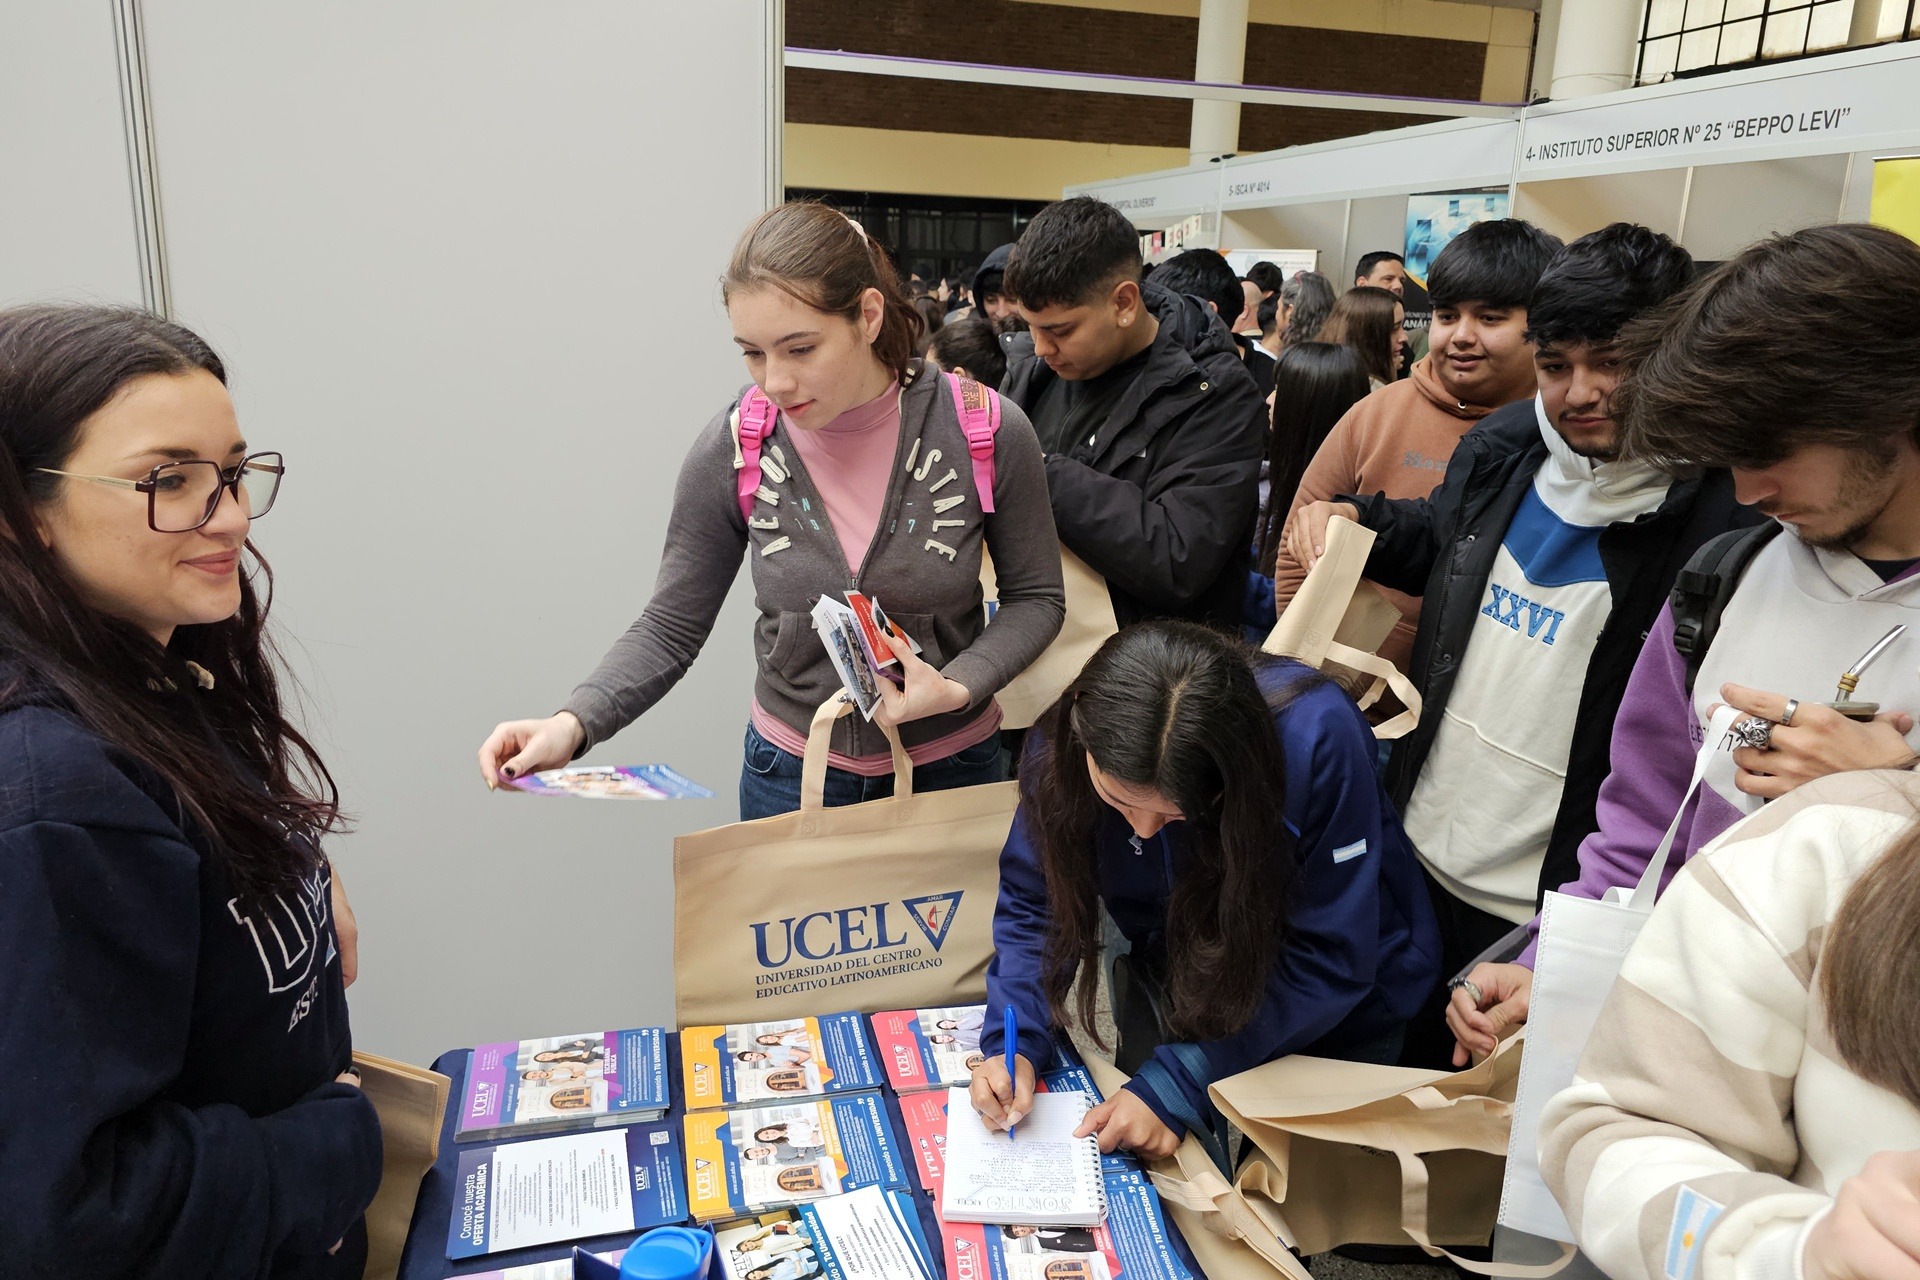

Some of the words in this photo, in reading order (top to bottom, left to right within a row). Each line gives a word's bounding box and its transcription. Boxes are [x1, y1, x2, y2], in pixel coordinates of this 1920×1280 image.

[1525, 146, 1536, 162] 4-
[1539, 138, 1603, 160] INSTITUTO
[1607, 127, 1679, 152] SUPERIOR
[1704, 123, 1722, 142] 25
[1481, 583, 1565, 645] XXVI
[749, 902, 908, 968] UCEL
[756, 961, 843, 986] UNIVERSIDAD
[846, 957, 870, 970] DEL
[873, 948, 922, 965] CENTRO
[756, 978, 827, 999] EDUCATIVO
[831, 957, 943, 986] LATINOAMERICANO
[652, 1028, 660, 1062] UNIVERSIDAD
[848, 1015, 865, 1047] UNIVERSIDAD
[654, 1062, 660, 1070] TU
[857, 1047, 866, 1056] TU
[894, 1052, 914, 1078] UCEL
[693, 1071, 709, 1097] UCEL
[860, 1059, 875, 1084] Bienvenido
[1076, 1069, 1101, 1105] NIVERSIDAD
[471, 1089, 489, 1117] UCEL
[865, 1096, 884, 1136] UNIVERSIDAD
[877, 1136, 886, 1146] TU
[635, 1170, 645, 1191] UCEL
[881, 1151, 897, 1182] Bienvenido
[462, 1173, 475, 1204] nuestra
[471, 1162, 489, 1212] ACADÉMICA
[695, 1168, 712, 1200] UCEL
[986, 1195, 1073, 1213] SORTEO
[1136, 1185, 1160, 1233] UNIVERSIDAD
[458, 1204, 474, 1239] Conocé
[471, 1211, 485, 1246] OFERTA
[803, 1210, 829, 1252] Universidad
[1153, 1233, 1163, 1243] TU
[821, 1251, 834, 1262] Tu
[992, 1245, 1001, 1280] ww.ucel.edu.ar
[1159, 1250, 1177, 1280] ienvenido
